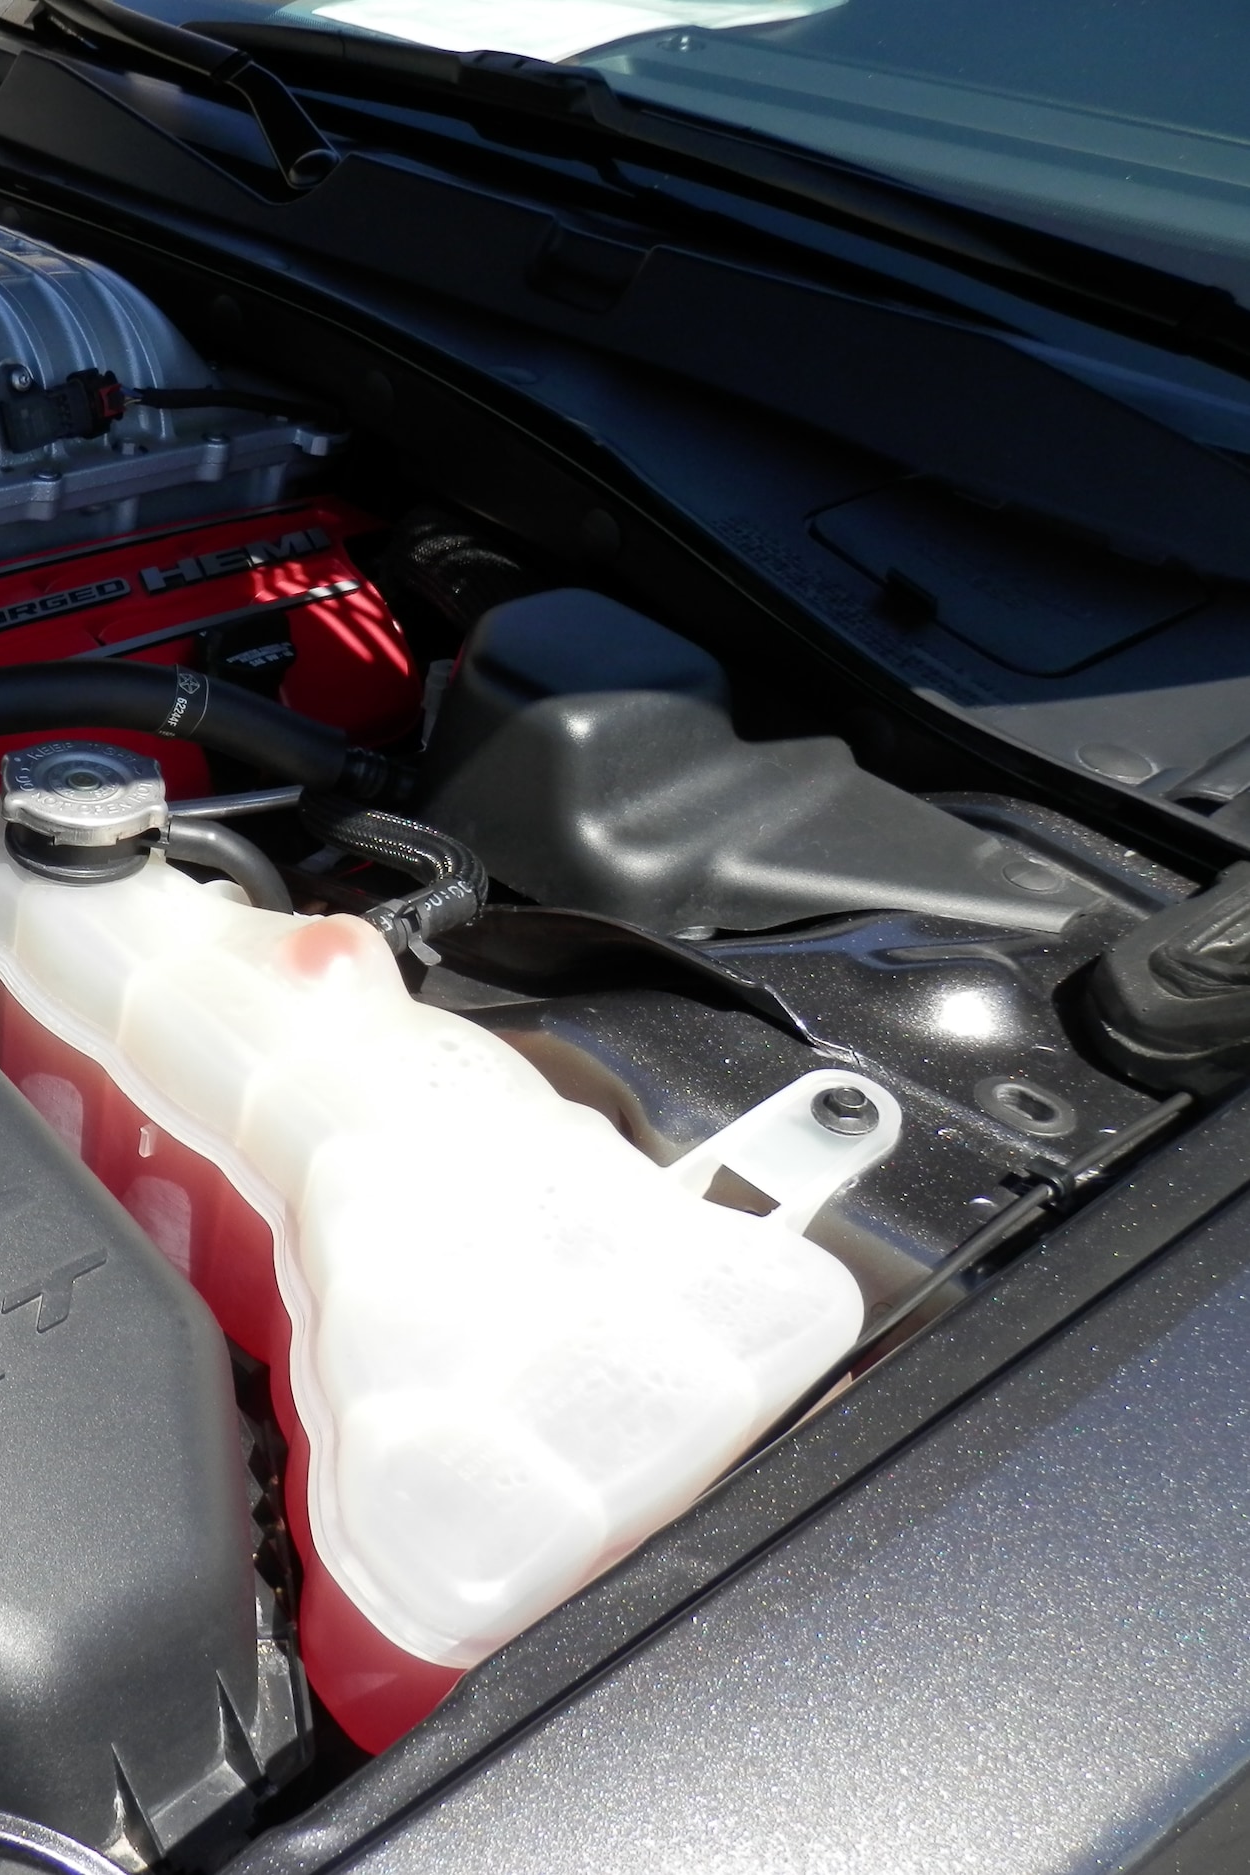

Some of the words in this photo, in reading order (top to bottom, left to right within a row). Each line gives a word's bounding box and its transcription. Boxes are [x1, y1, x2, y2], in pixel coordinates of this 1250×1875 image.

[139, 526, 332, 593] HEMI
[26, 741, 74, 761] KEEP
[79, 801, 133, 816] OPEN
